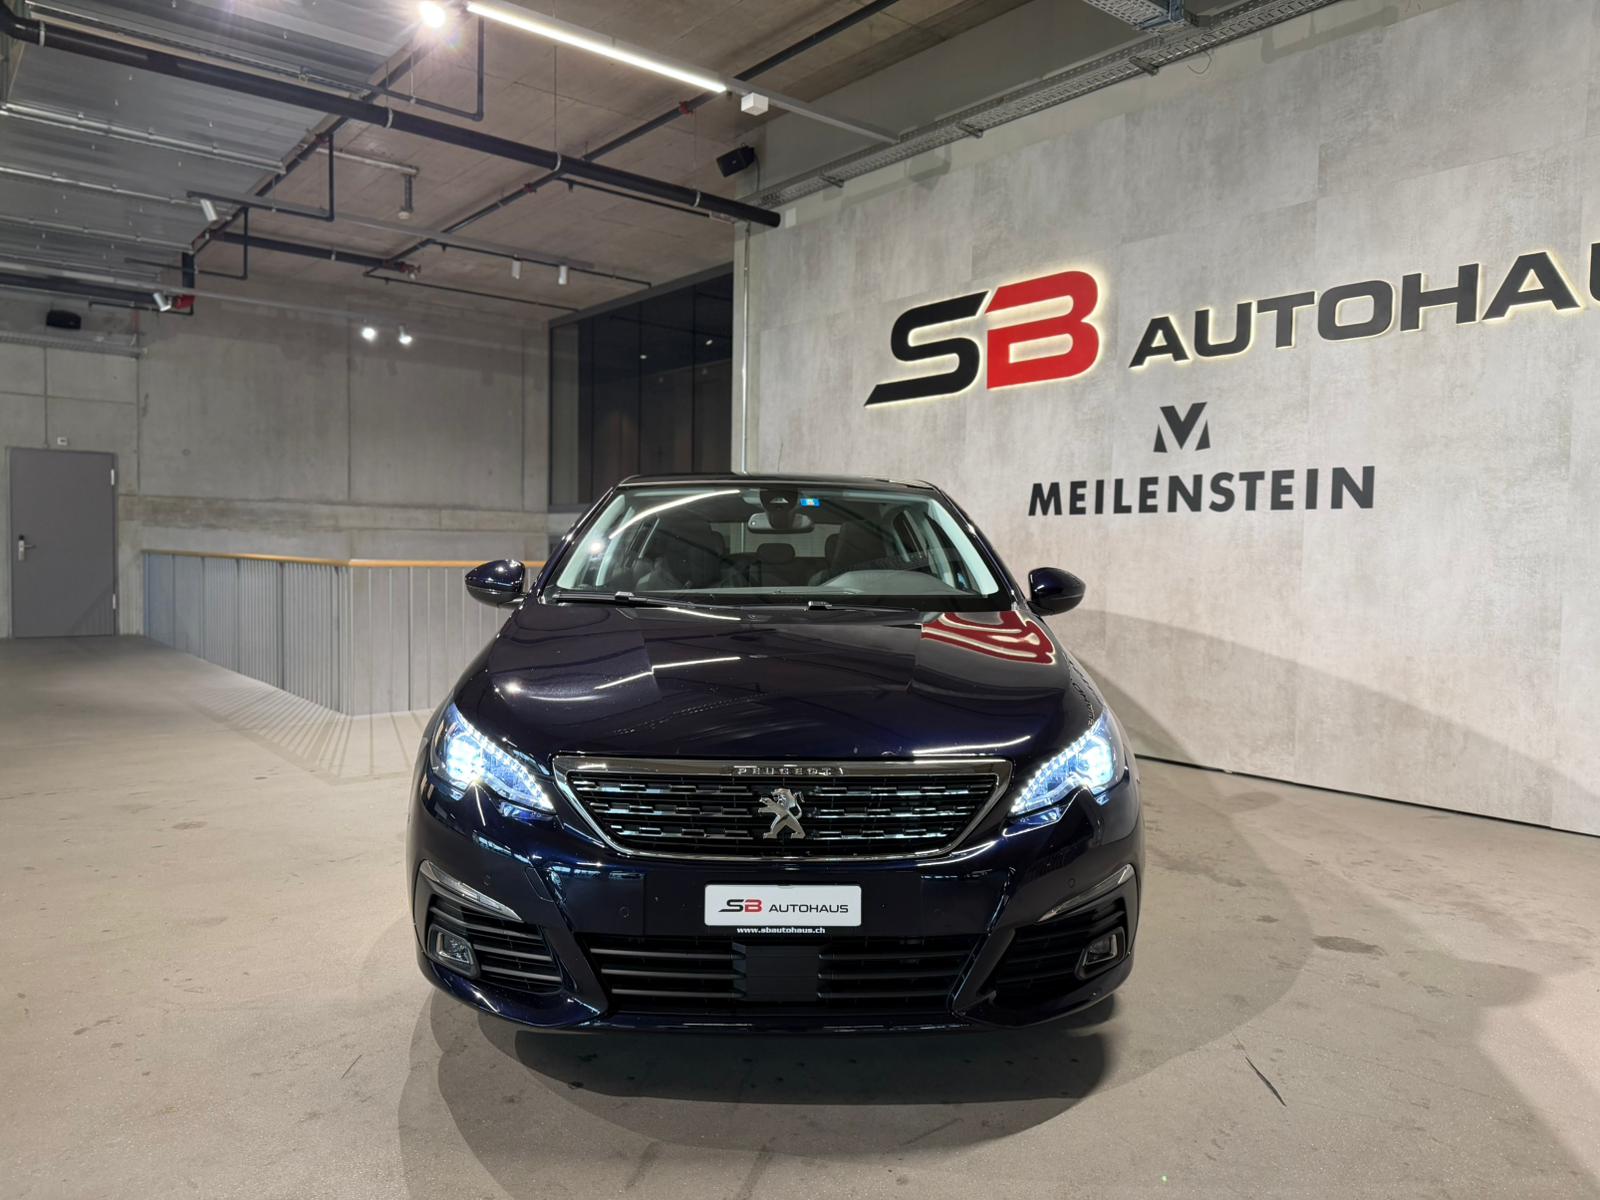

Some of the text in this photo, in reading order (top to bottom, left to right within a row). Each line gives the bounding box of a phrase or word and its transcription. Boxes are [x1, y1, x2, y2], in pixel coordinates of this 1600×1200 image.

[864, 242, 1600, 406] SB AUTOHA
[1028, 466, 1375, 516] MEILENSTEIN
[718, 899, 848, 913] SB AUTOHAUS
[736, 926, 826, 934] www.sbautohaus.ch
